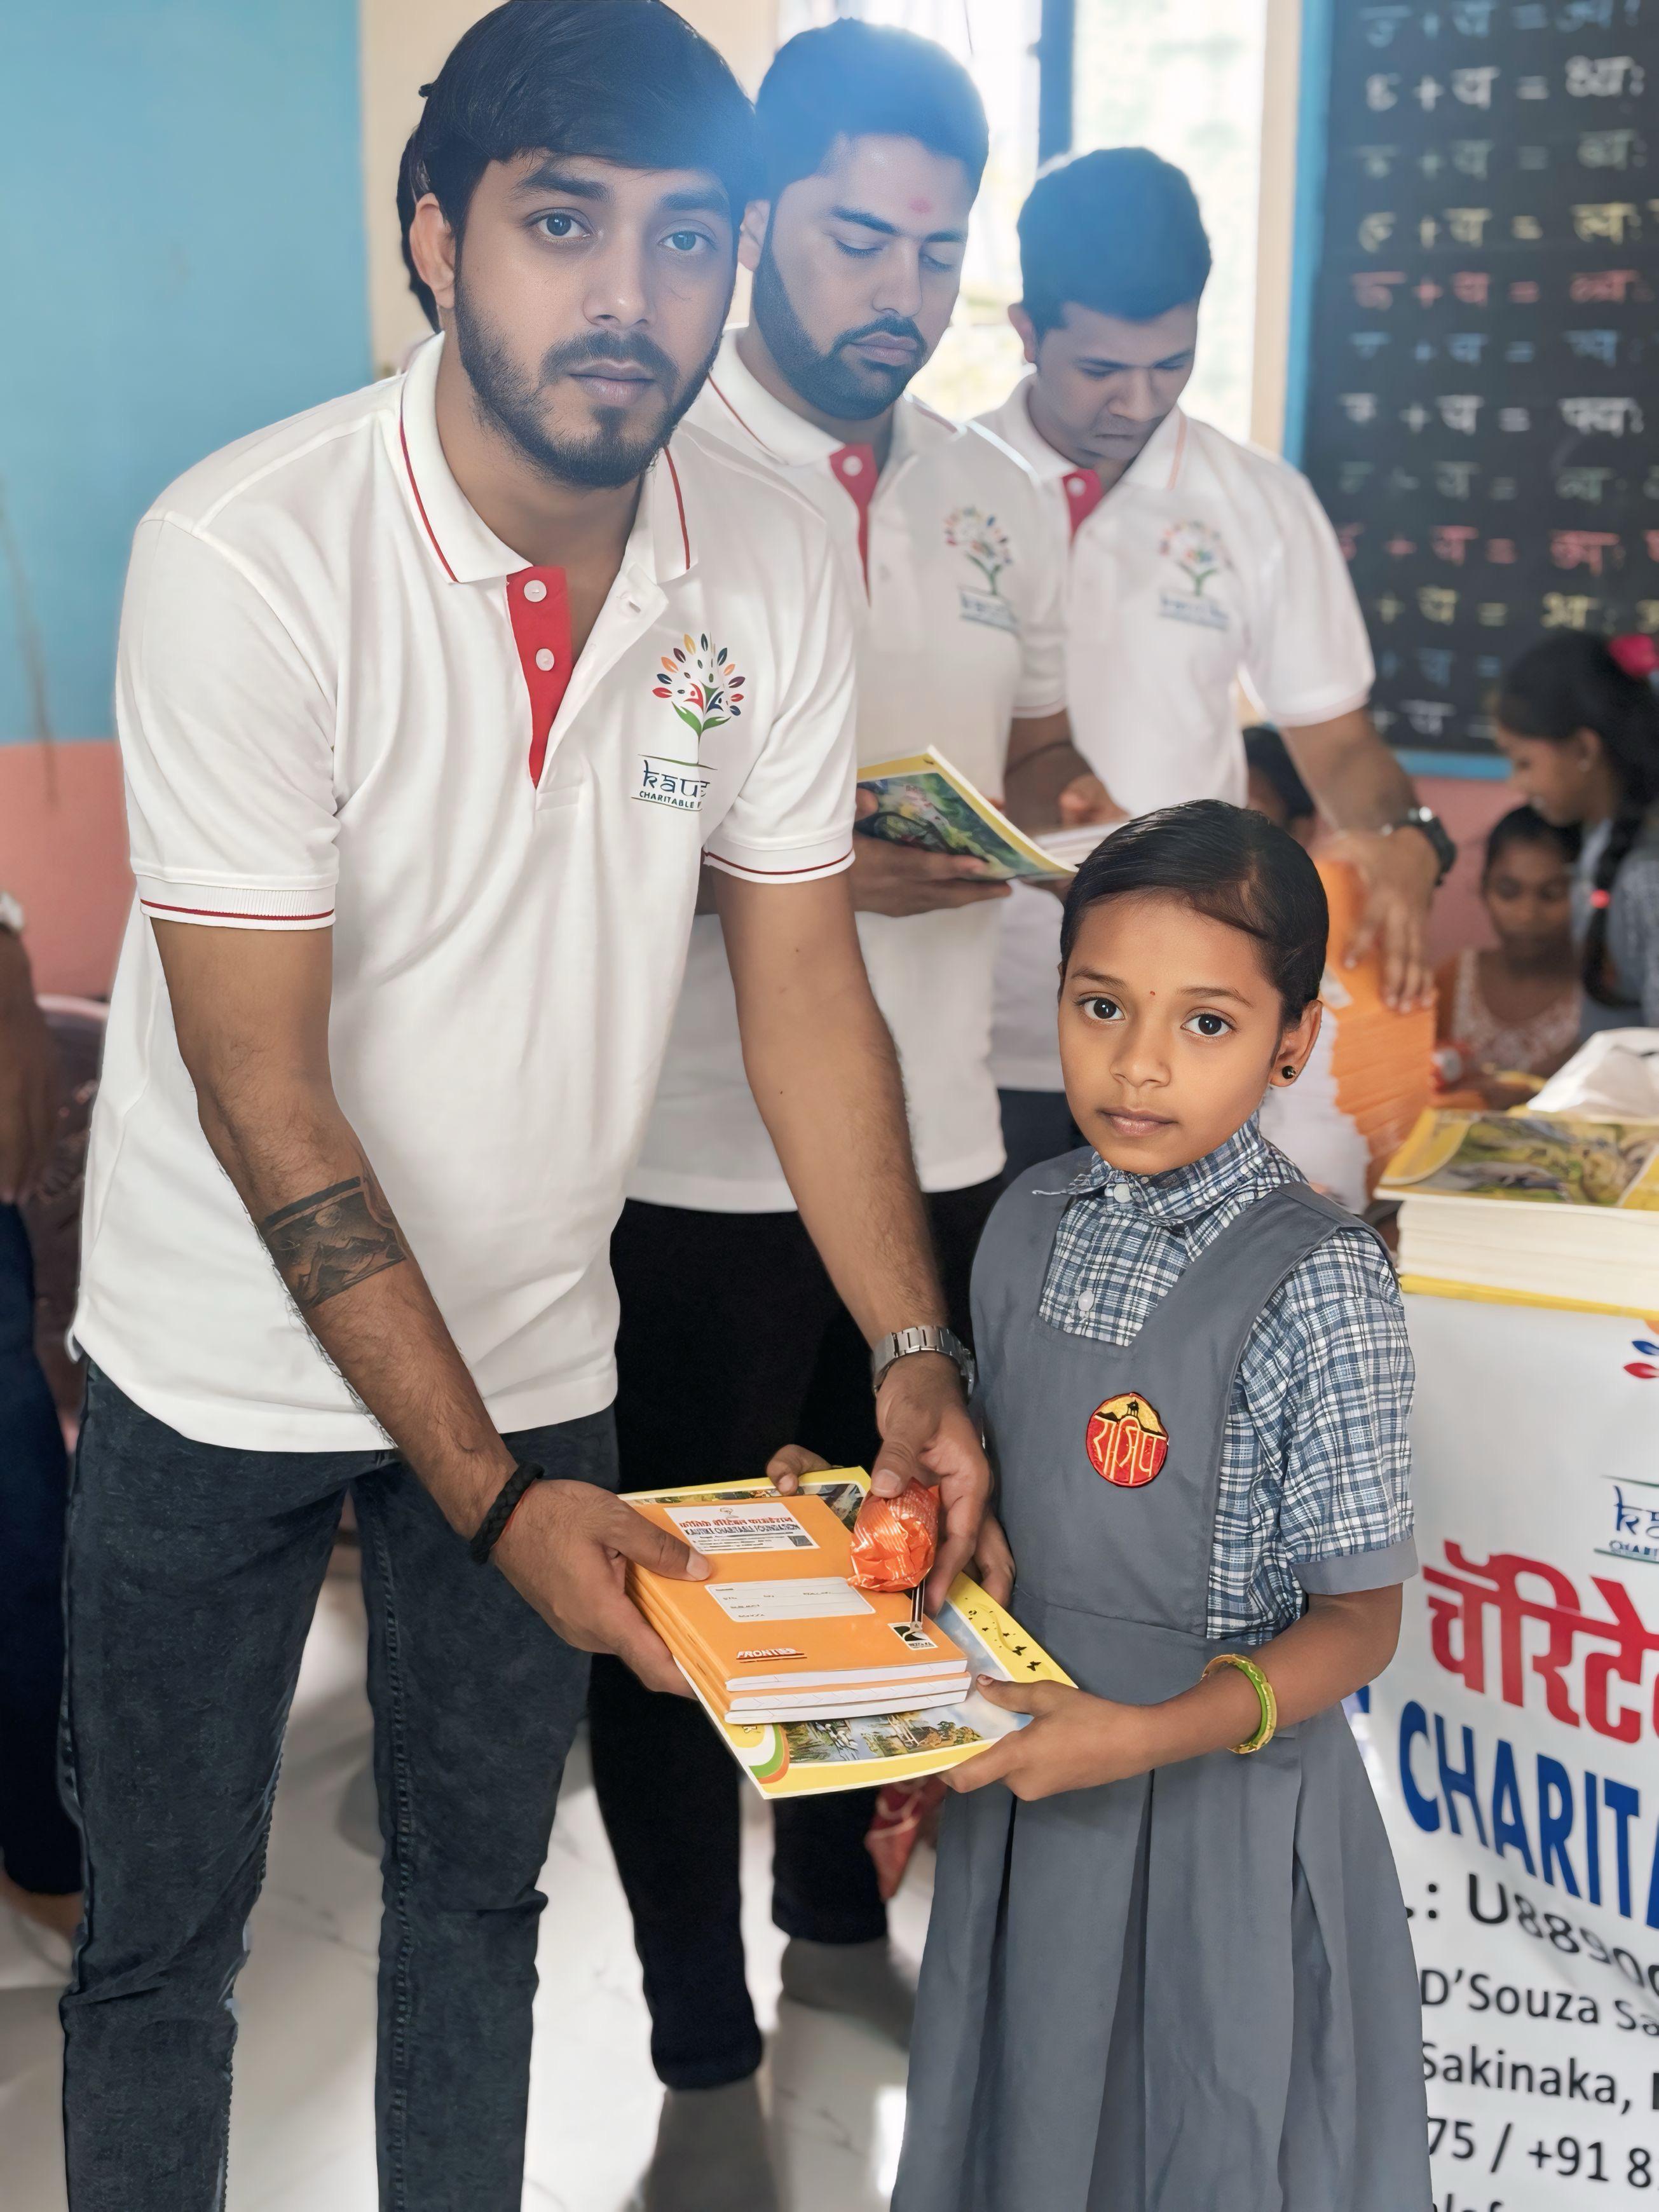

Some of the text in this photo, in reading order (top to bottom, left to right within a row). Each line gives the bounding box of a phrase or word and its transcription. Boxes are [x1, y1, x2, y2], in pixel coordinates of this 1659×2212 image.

[639, 790, 695, 809] CHARITABLE
[1400, 1700, 1659, 1931] CHARIT
[1423, 2041, 1630, 2115] Sakinaka,
